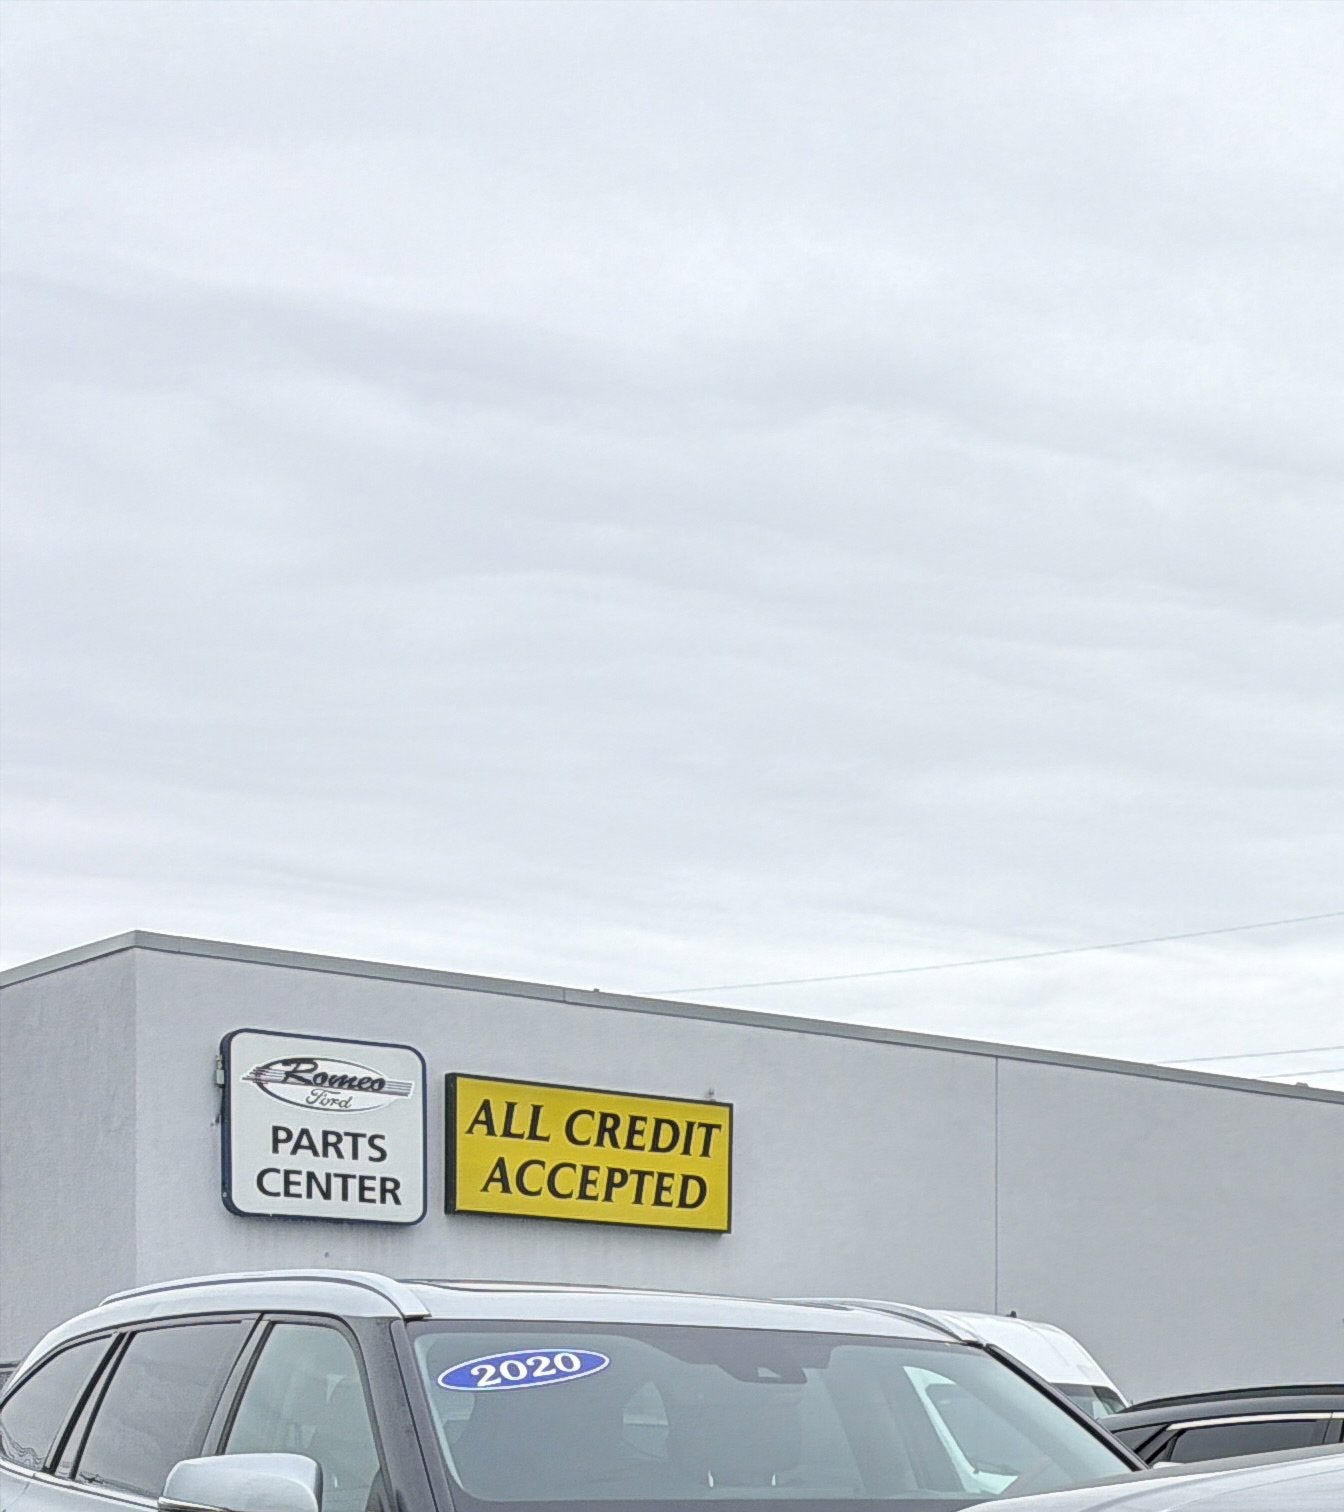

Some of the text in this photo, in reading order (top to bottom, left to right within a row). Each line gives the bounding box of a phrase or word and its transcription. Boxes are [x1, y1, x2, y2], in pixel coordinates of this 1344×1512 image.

[281, 1059, 386, 1093] Romeo
[305, 1089, 353, 1110] Ford
[271, 1125, 387, 1163] PARTS
[465, 1099, 722, 1158] ALL CREDIT
[256, 1167, 401, 1205] CENTER
[481, 1156, 708, 1209] ACCEPTED
[470, 1352, 581, 1387] 2020
